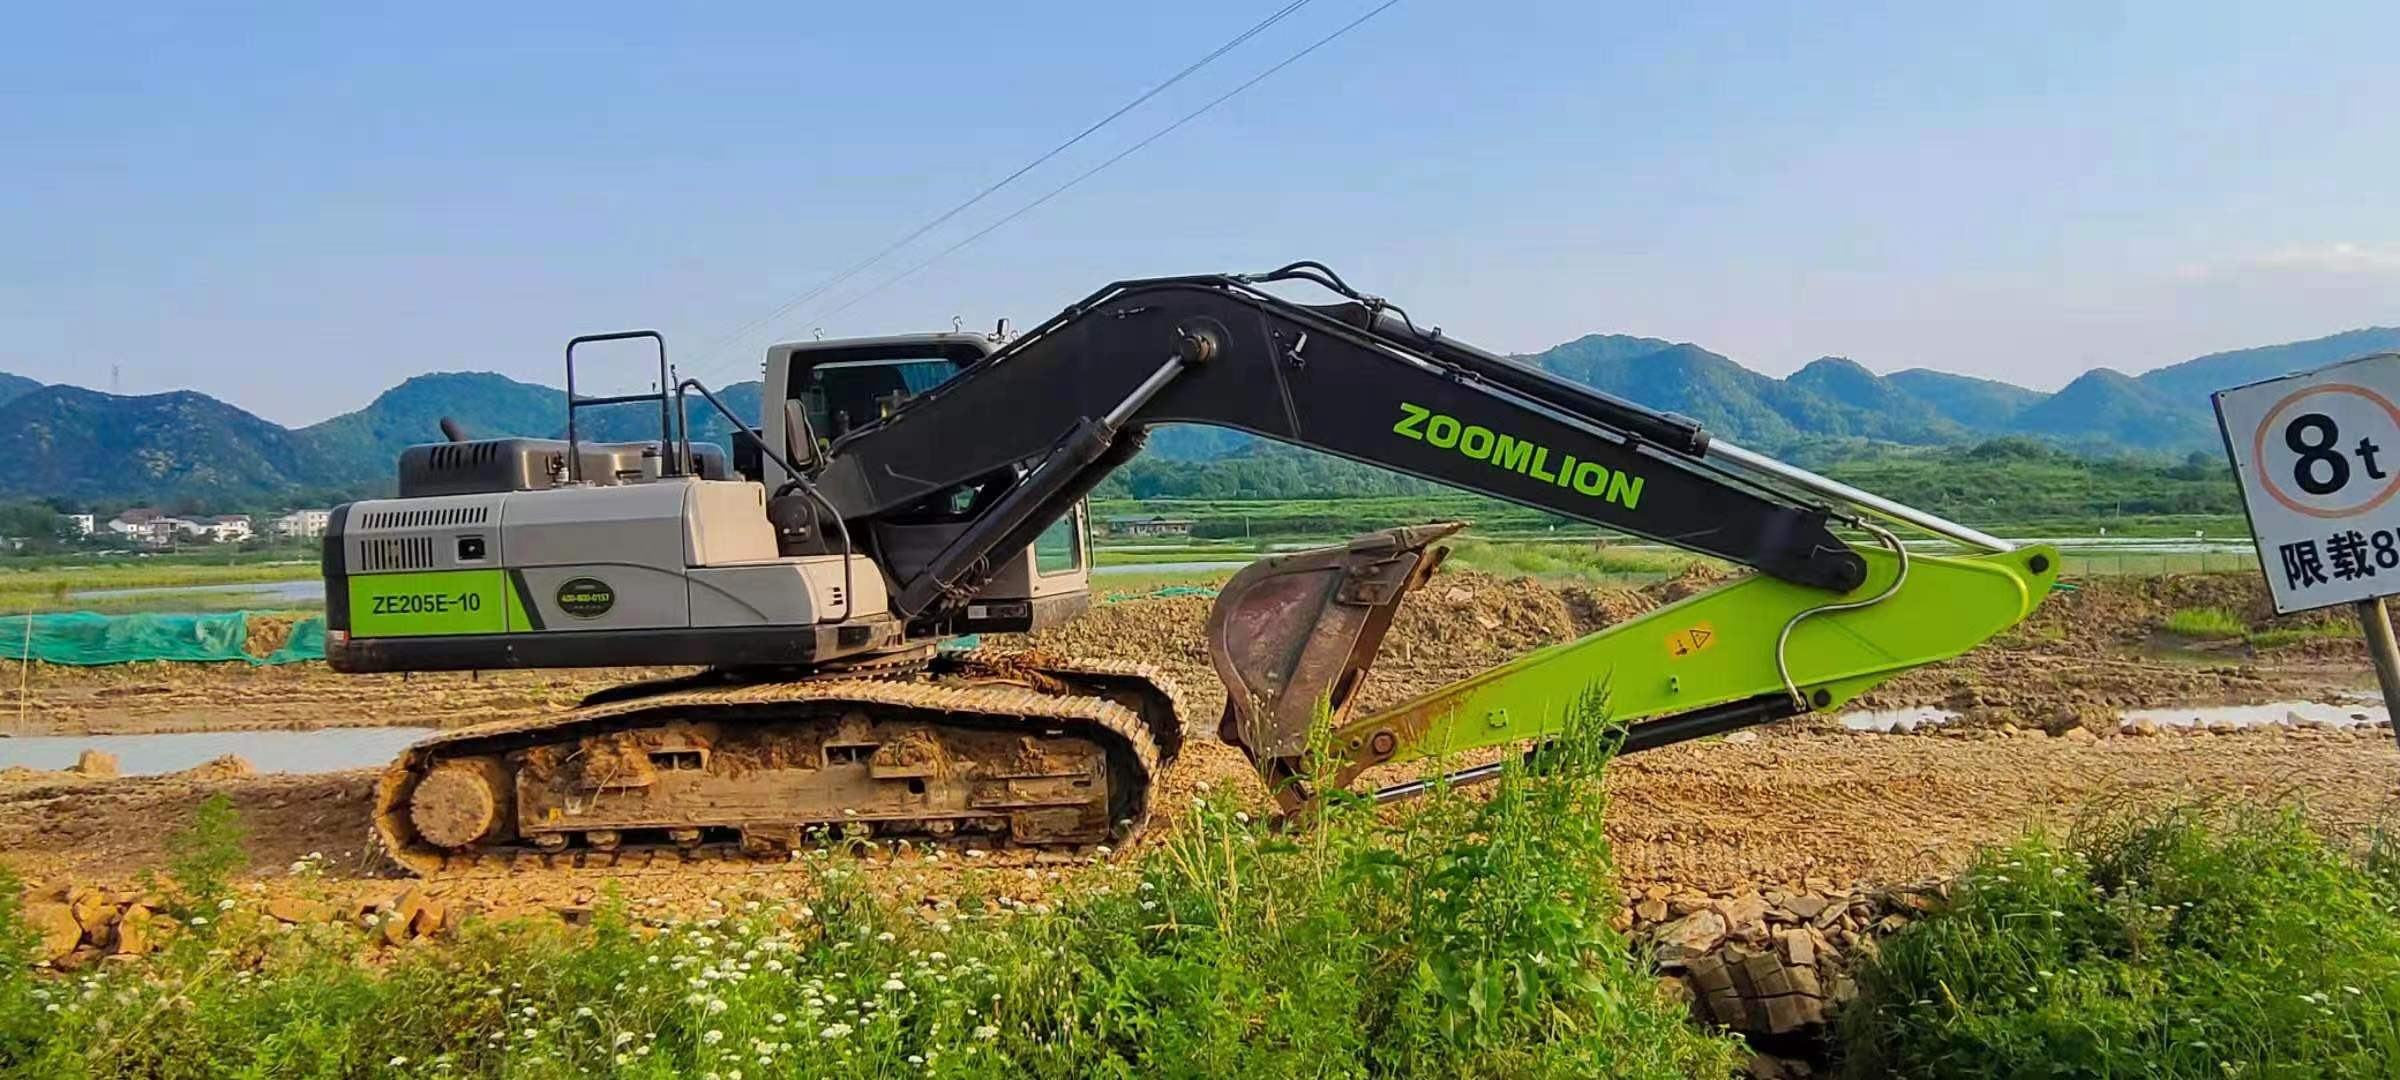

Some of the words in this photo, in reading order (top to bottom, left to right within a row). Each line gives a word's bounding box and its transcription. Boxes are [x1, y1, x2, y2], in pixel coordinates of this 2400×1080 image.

[1393, 402, 1644, 509] ZOOMLION
[2279, 527, 2400, 590] 限载8
[372, 592, 481, 614] ZE205E-10
